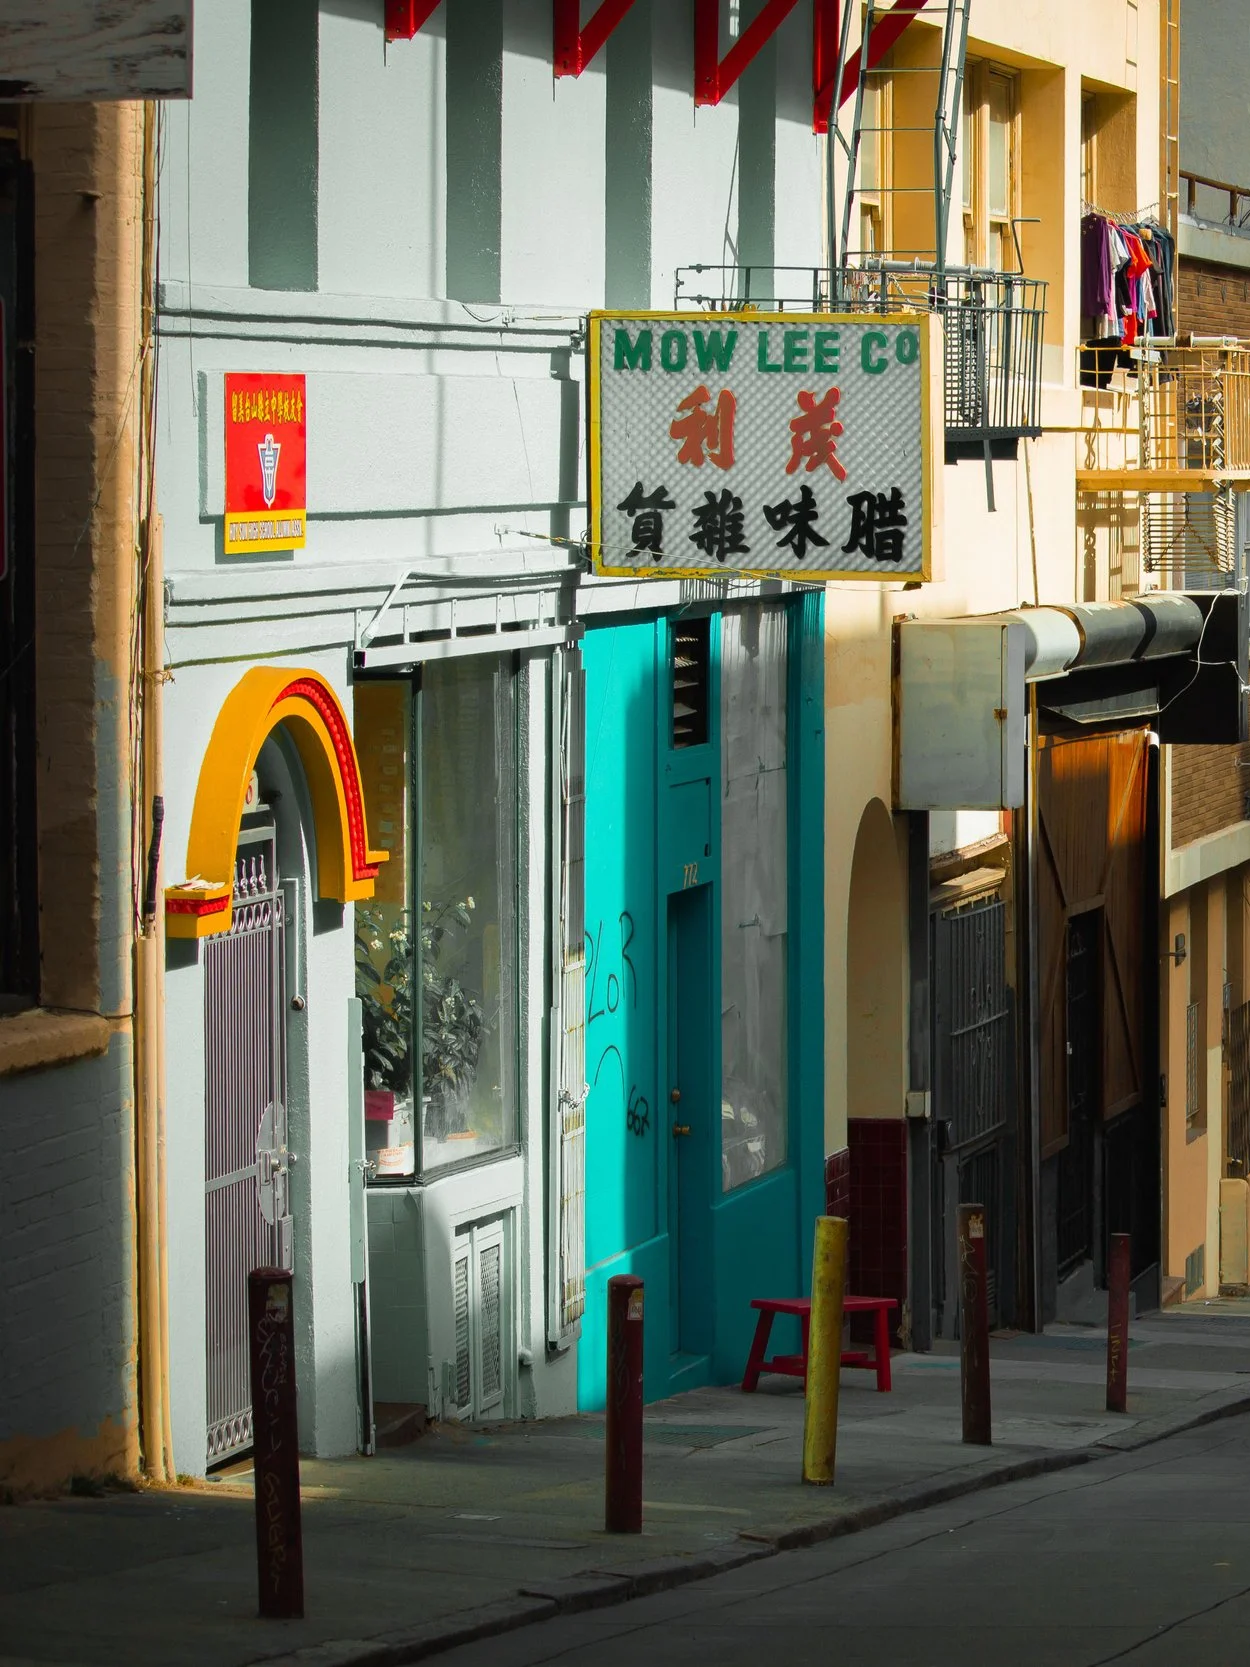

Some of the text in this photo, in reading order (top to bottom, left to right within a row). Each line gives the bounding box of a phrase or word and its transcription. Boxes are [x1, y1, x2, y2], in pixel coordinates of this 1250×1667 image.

[613, 329, 738, 373] MOW
[758, 330, 840, 374] LEE
[248, 521, 259, 540] HIGH
[259, 520, 275, 540] SCHOOL
